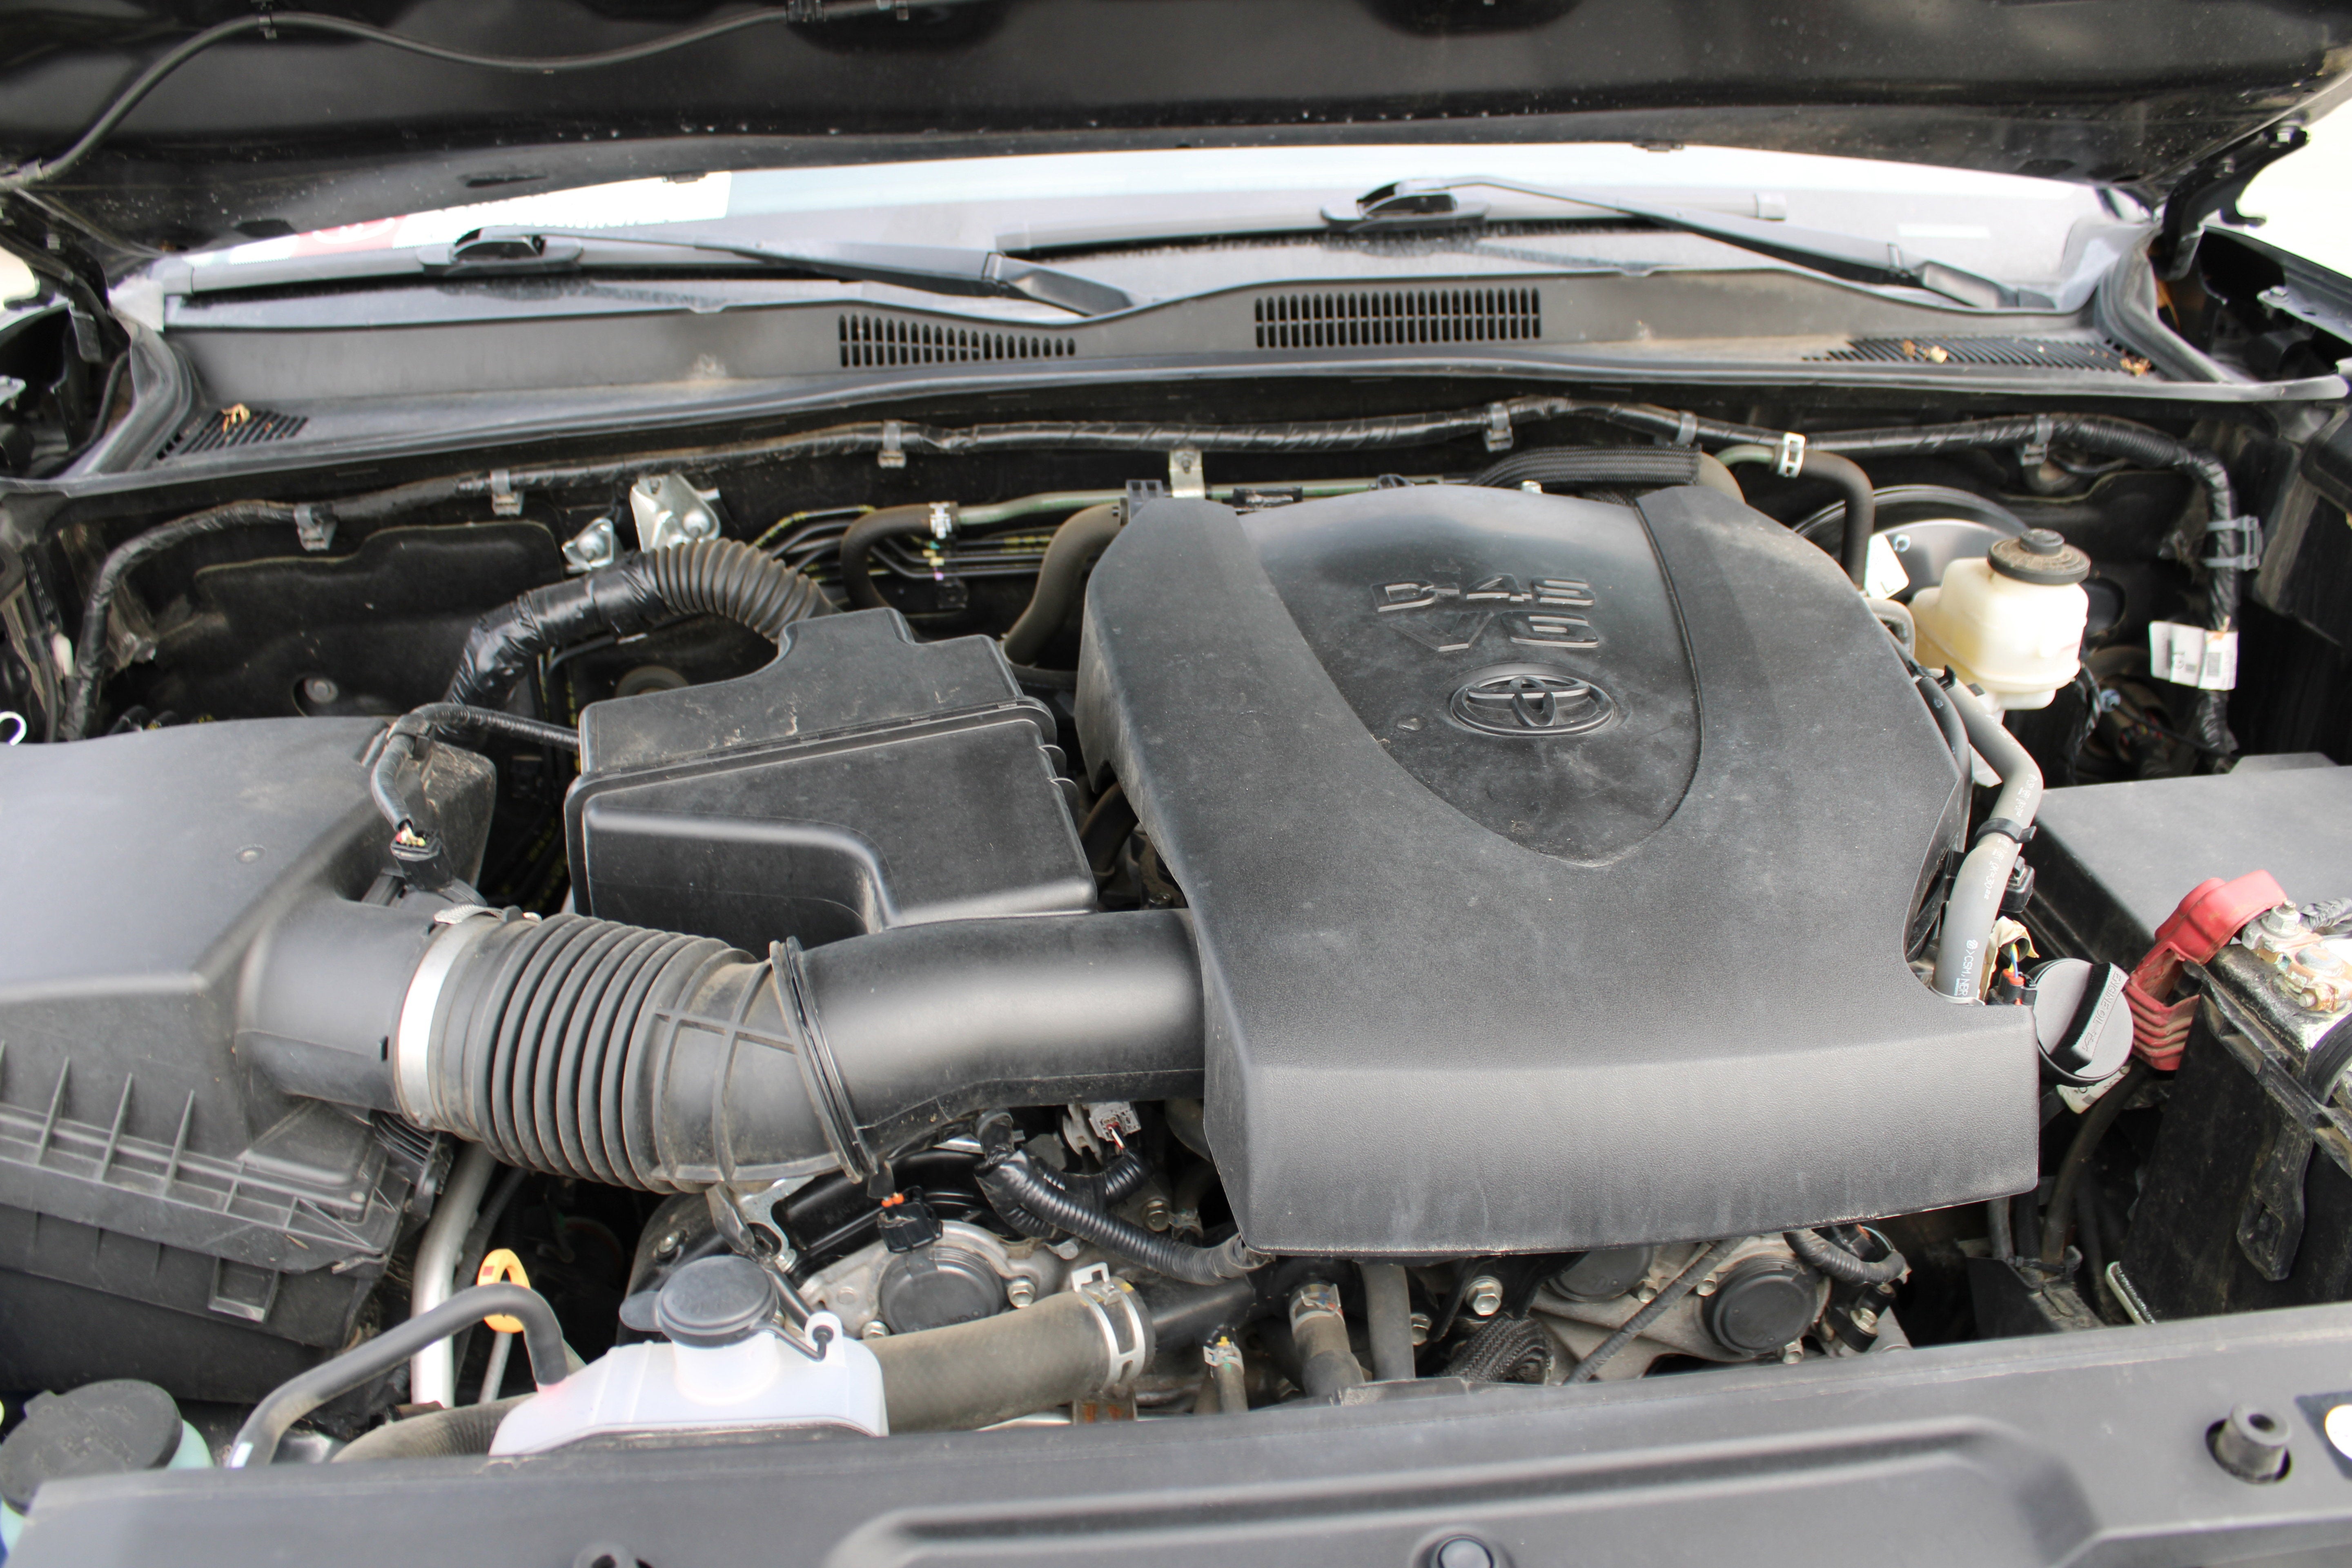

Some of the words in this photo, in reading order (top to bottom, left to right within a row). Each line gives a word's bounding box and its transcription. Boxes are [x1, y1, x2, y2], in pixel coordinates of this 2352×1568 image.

[1370, 574, 1596, 612] D-4S
[1388, 610, 1600, 652] V6
[2100, 971, 2122, 1011] ENGINE
[2092, 1009, 2105, 1025] OIL
